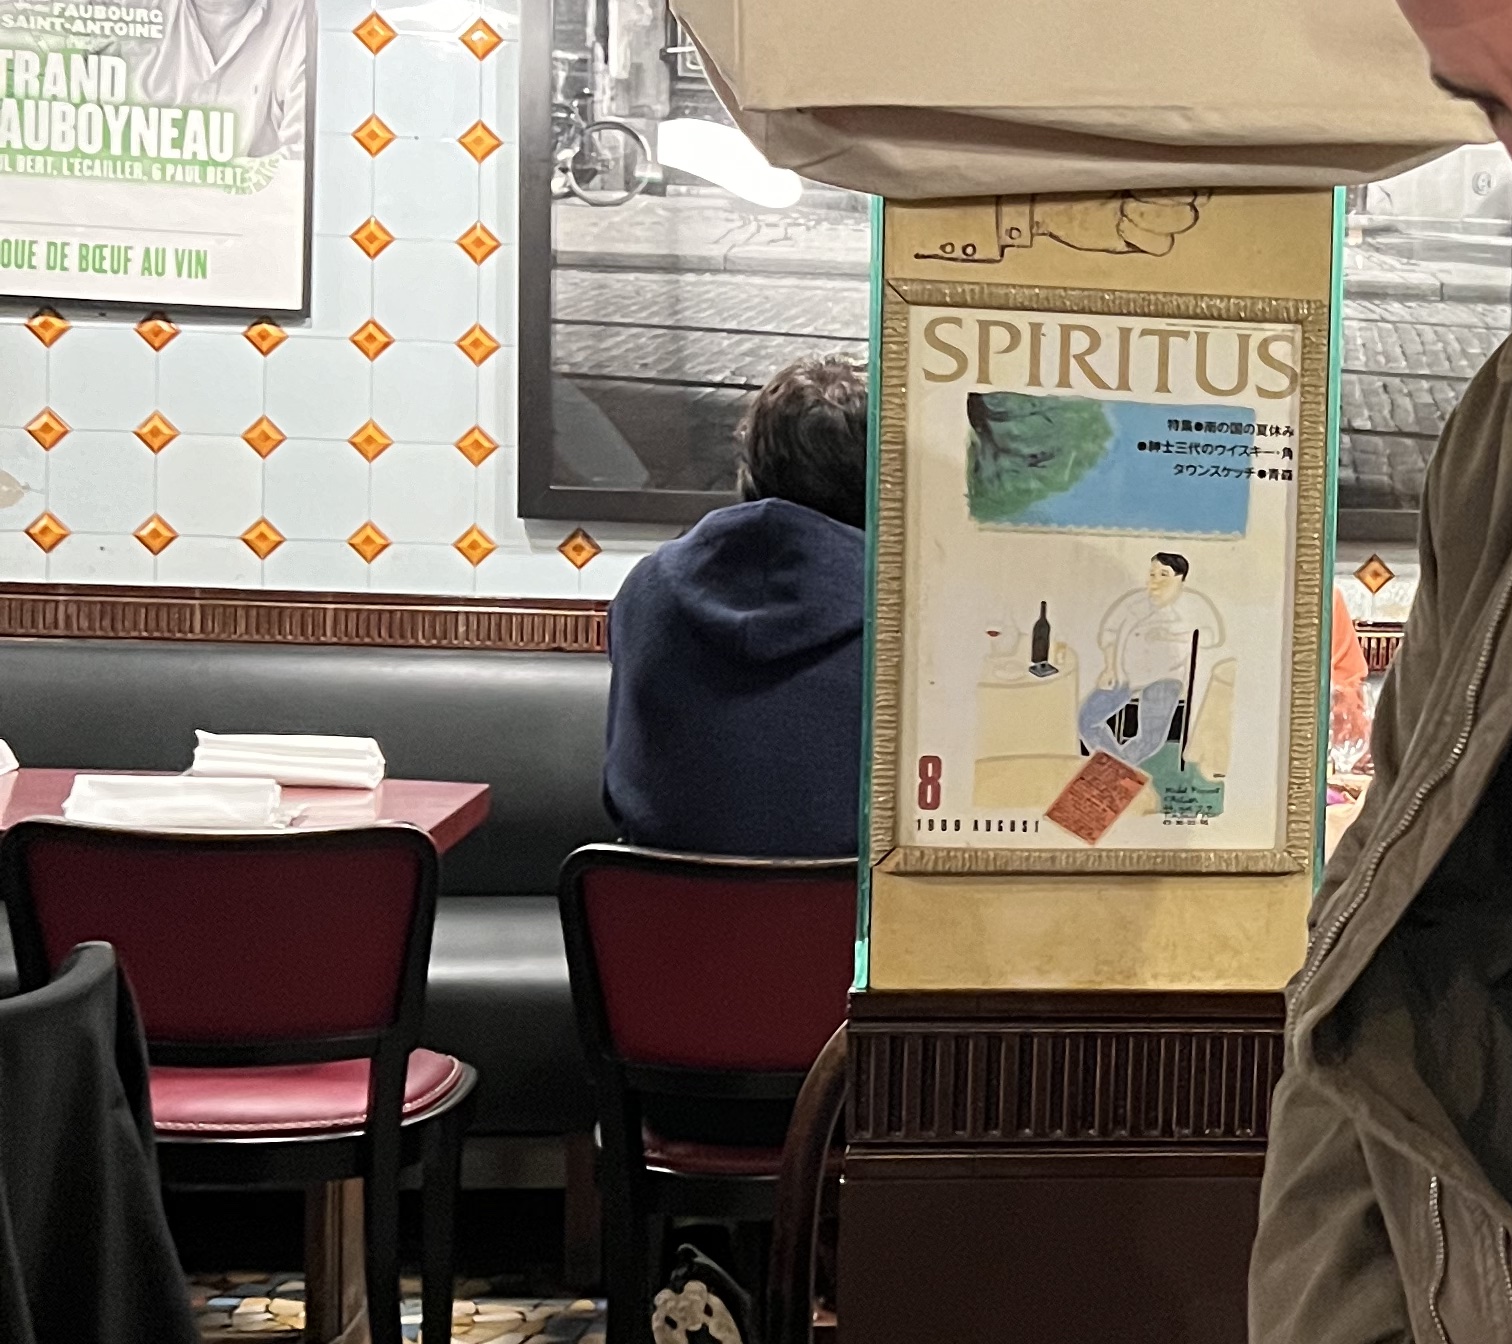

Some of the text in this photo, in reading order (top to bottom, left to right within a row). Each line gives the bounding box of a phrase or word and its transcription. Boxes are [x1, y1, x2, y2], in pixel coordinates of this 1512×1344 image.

[1, 14, 164, 39] SAINT-ANTOINE
[52, 3, 164, 23] FAUBOURG
[0, 98, 234, 162] AUBOYNEAU
[166, 165, 202, 184] PAUL
[46, 241, 70, 272] DE
[78, 243, 134, 275] BŒUF
[141, 247, 167, 277] AU
[174, 248, 208, 279] VIN
[922, 316, 1298, 400] SPIRITUS
[918, 755, 942, 810] 8
